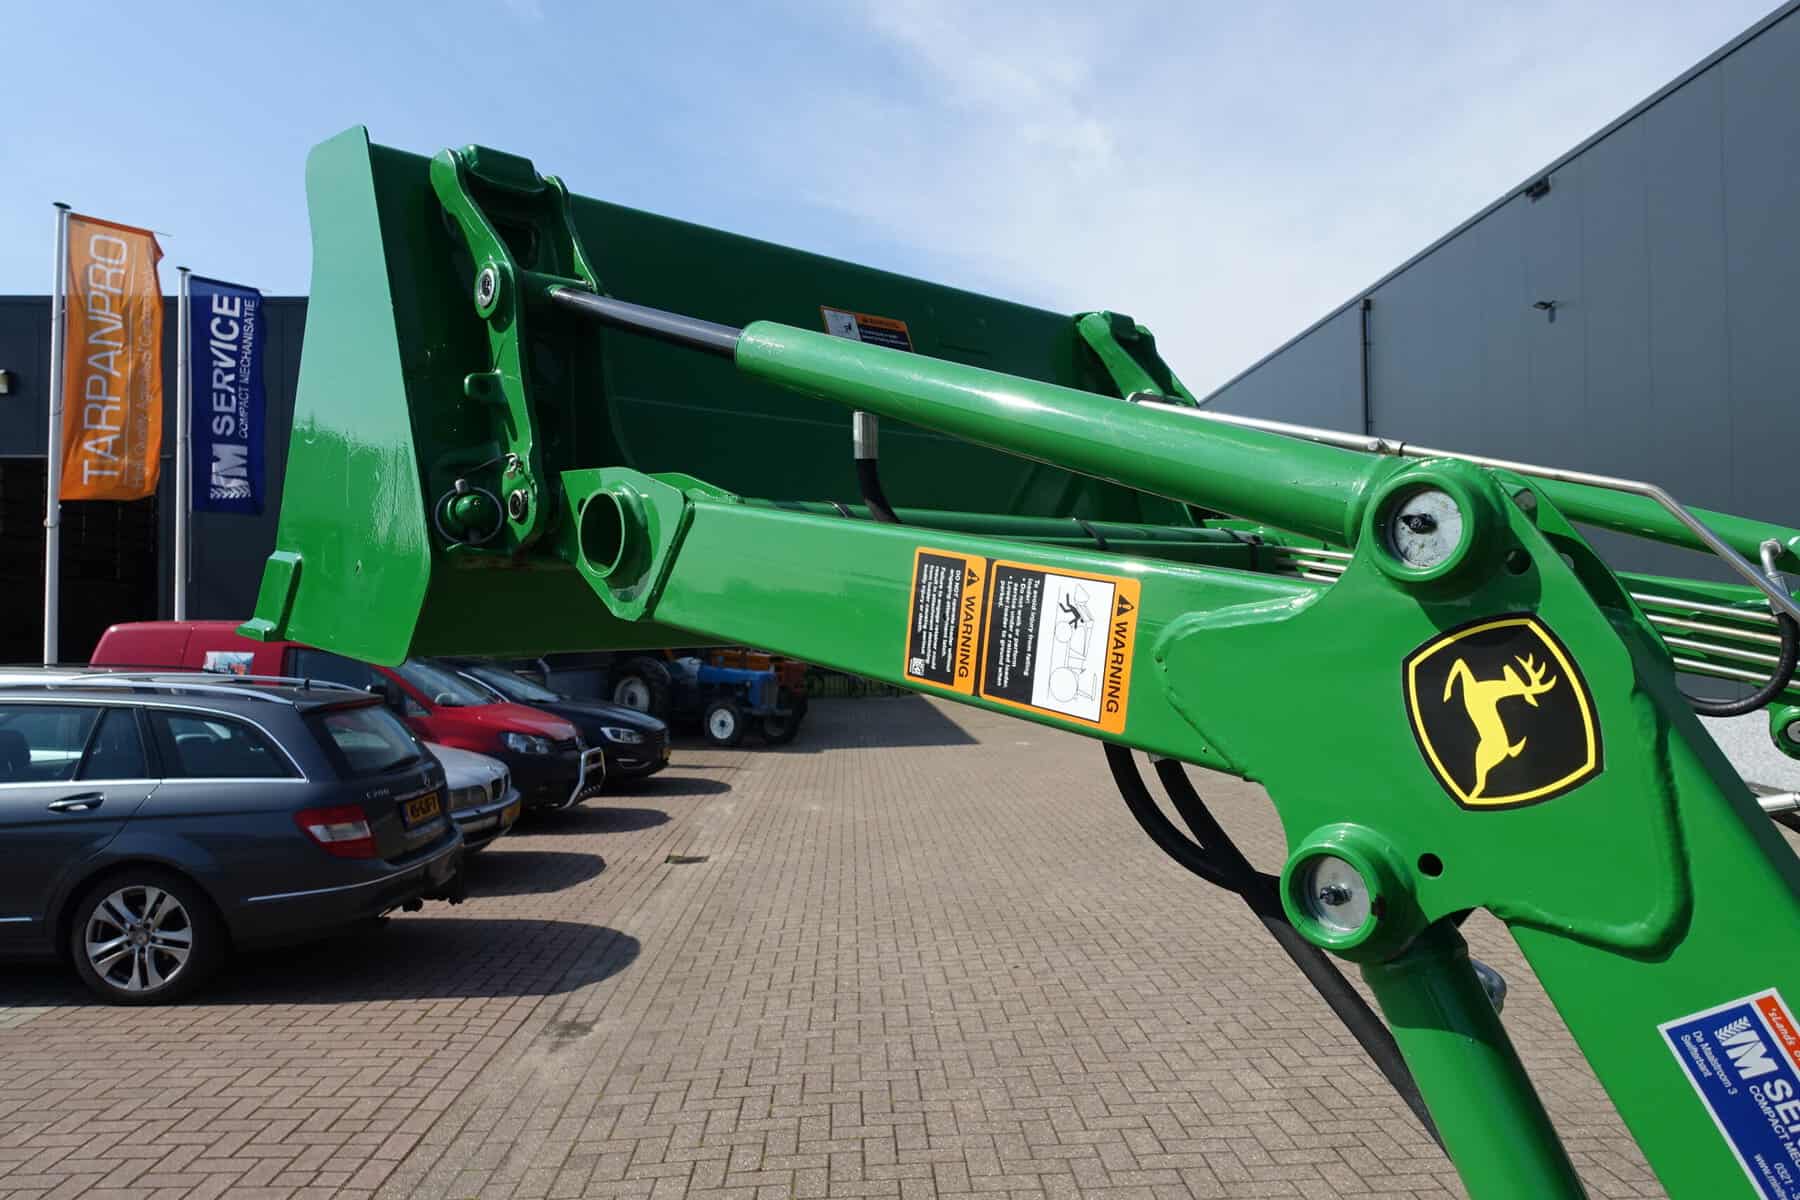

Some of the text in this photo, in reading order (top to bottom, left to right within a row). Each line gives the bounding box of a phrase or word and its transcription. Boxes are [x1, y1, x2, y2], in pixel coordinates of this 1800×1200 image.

[83, 234, 128, 485] TARPANPRO
[209, 293, 242, 437] SERVICE
[238, 298, 257, 440] COMPACT MECHANISATIE
[955, 569, 960, 581] DO
[1019, 583, 1025, 593] Do
[958, 595, 977, 680] WARNING
[1106, 621, 1128, 713] WARNING
[1692, 1030, 1704, 1043] De
[1728, 1087, 1739, 1095] 3
[1749, 1085, 1790, 1140] COMPACT
[1774, 1162, 1793, 1184] 0321
